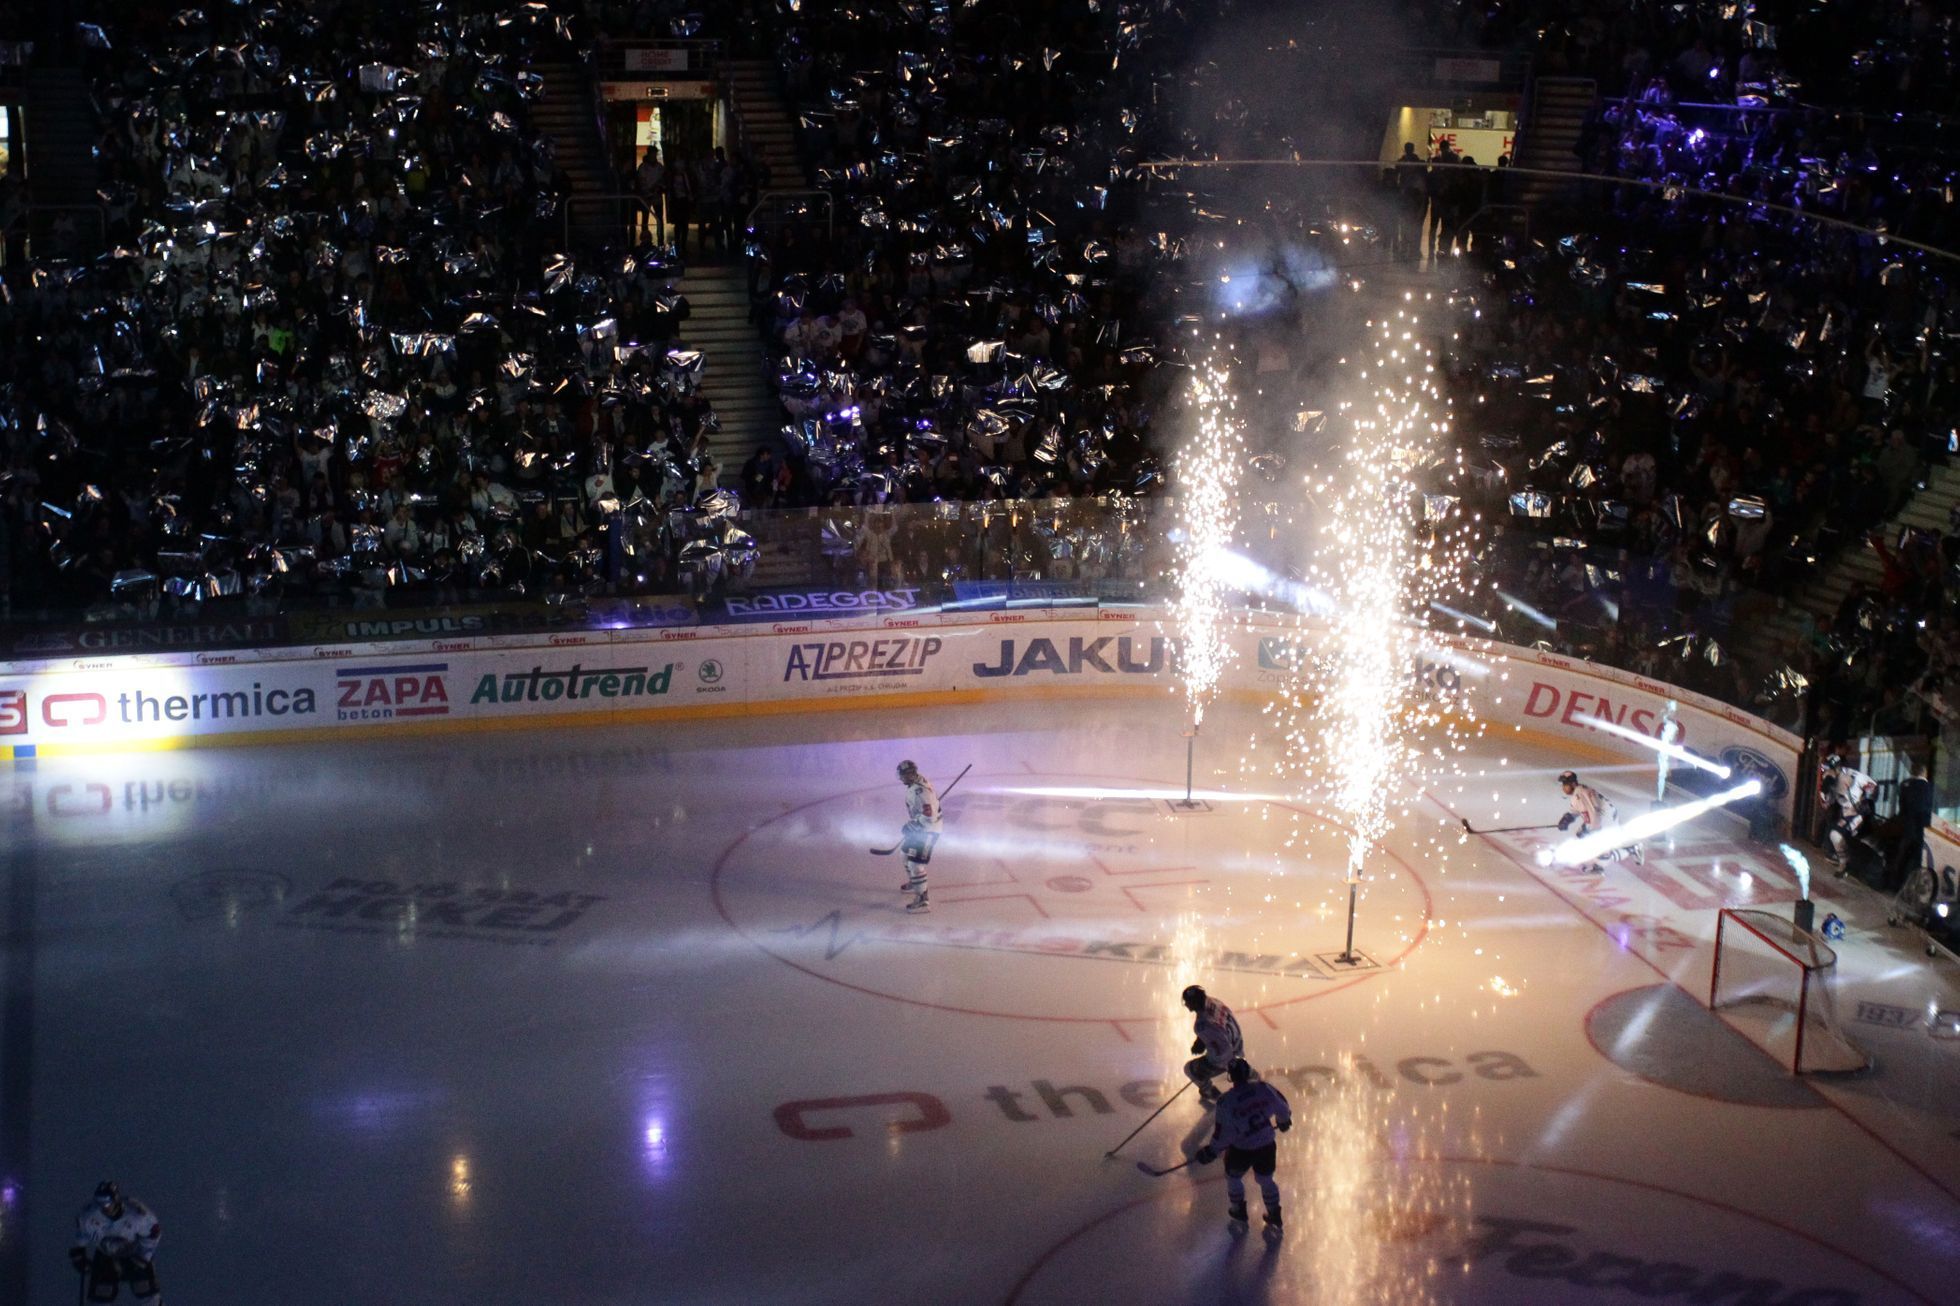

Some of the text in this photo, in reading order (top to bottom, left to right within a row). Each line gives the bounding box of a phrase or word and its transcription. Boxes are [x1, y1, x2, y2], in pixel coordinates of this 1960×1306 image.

[726, 588, 921, 616] RADEGAST
[77, 622, 277, 650] GENERALI
[346, 615, 483, 637] IMPULS
[117, 682, 317, 723] thermica
[337, 675, 449, 707] ZAPA
[337, 707, 393, 721] beton
